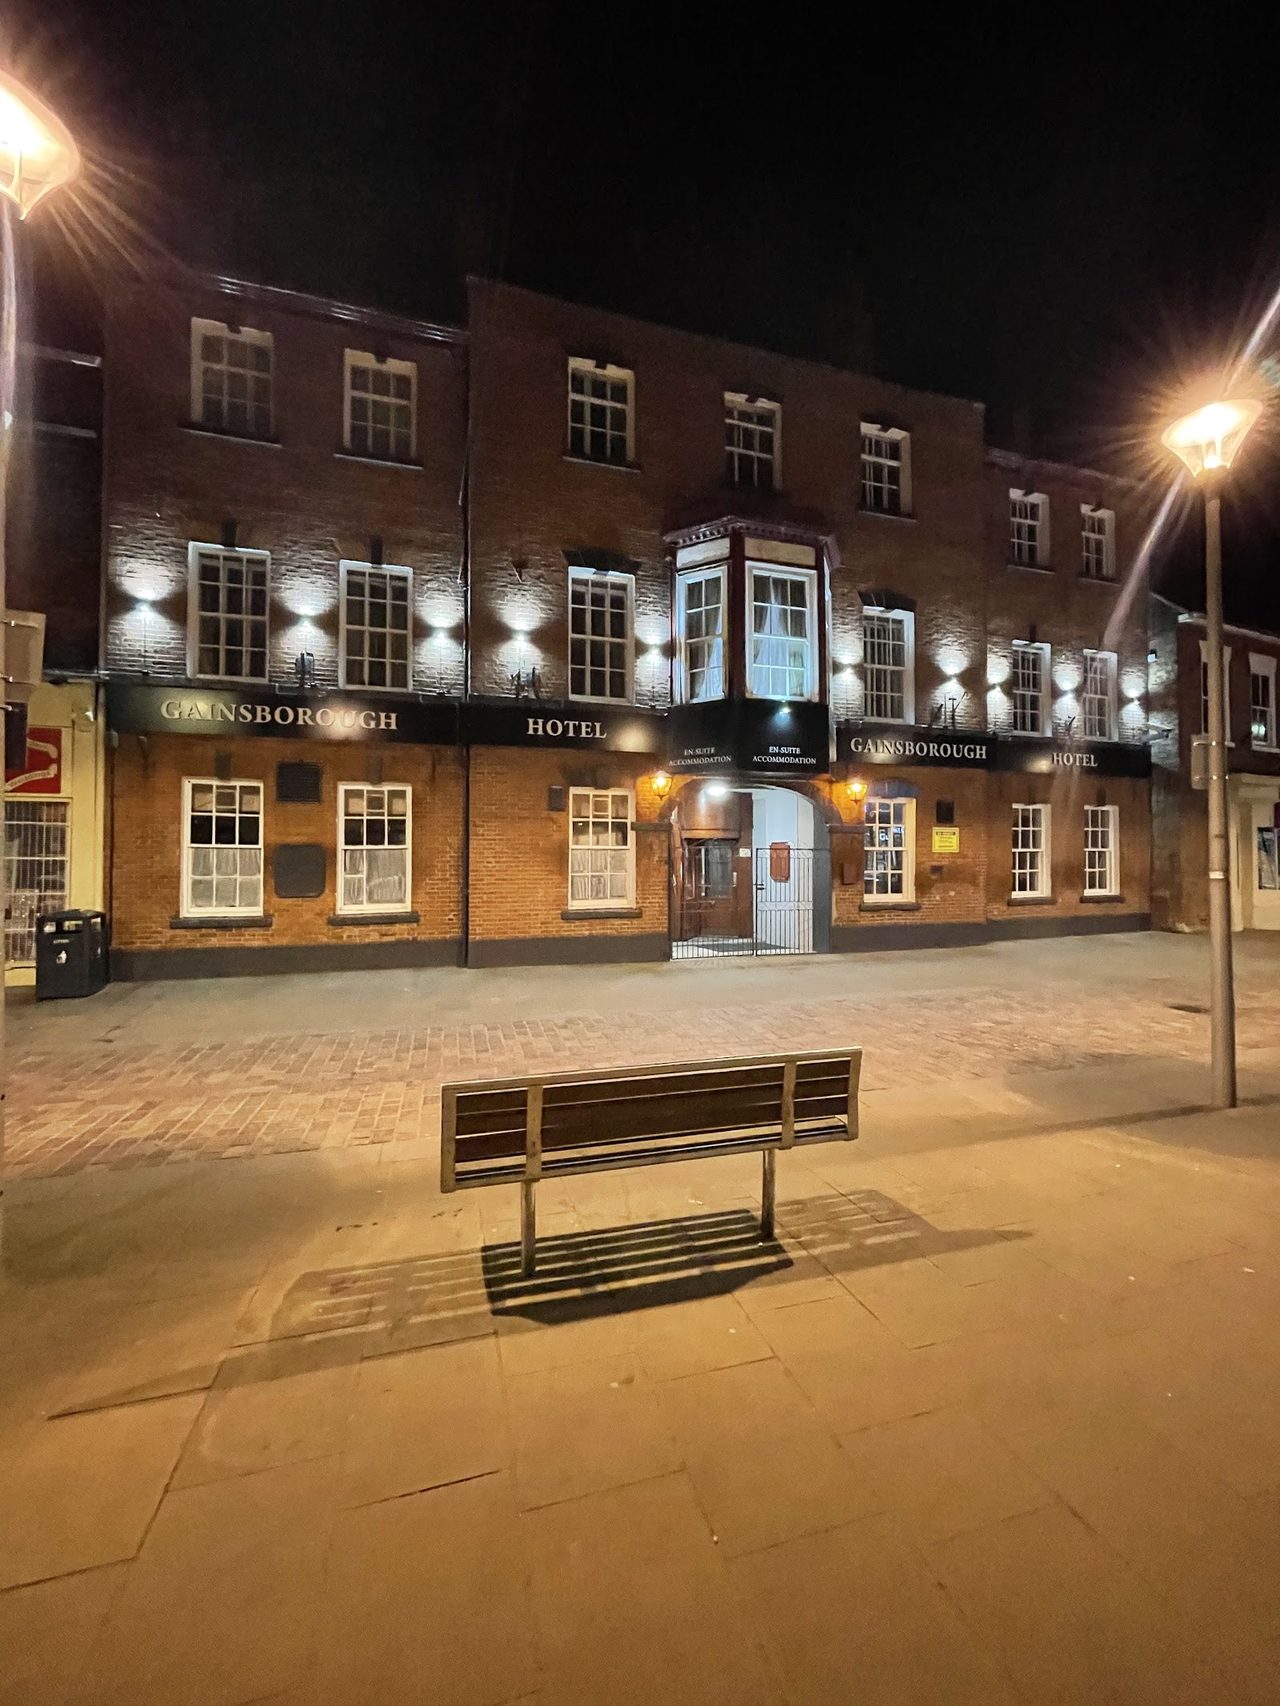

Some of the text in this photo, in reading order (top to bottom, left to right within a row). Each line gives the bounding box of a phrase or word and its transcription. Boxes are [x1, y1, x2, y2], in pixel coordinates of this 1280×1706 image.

[160, 700, 398, 730] GAINSBOROUGH
[526, 718, 607, 738] HOTEL
[684, 747, 716, 756] EN-SUITE
[769, 746, 801, 755] EN-SUITE
[850, 738, 987, 759] GAINSBOROUGH
[668, 755, 733, 766] ACCOMMODATION
[752, 755, 816, 765] ACCOMMODATION
[1052, 752, 1098, 767] HOTEL
